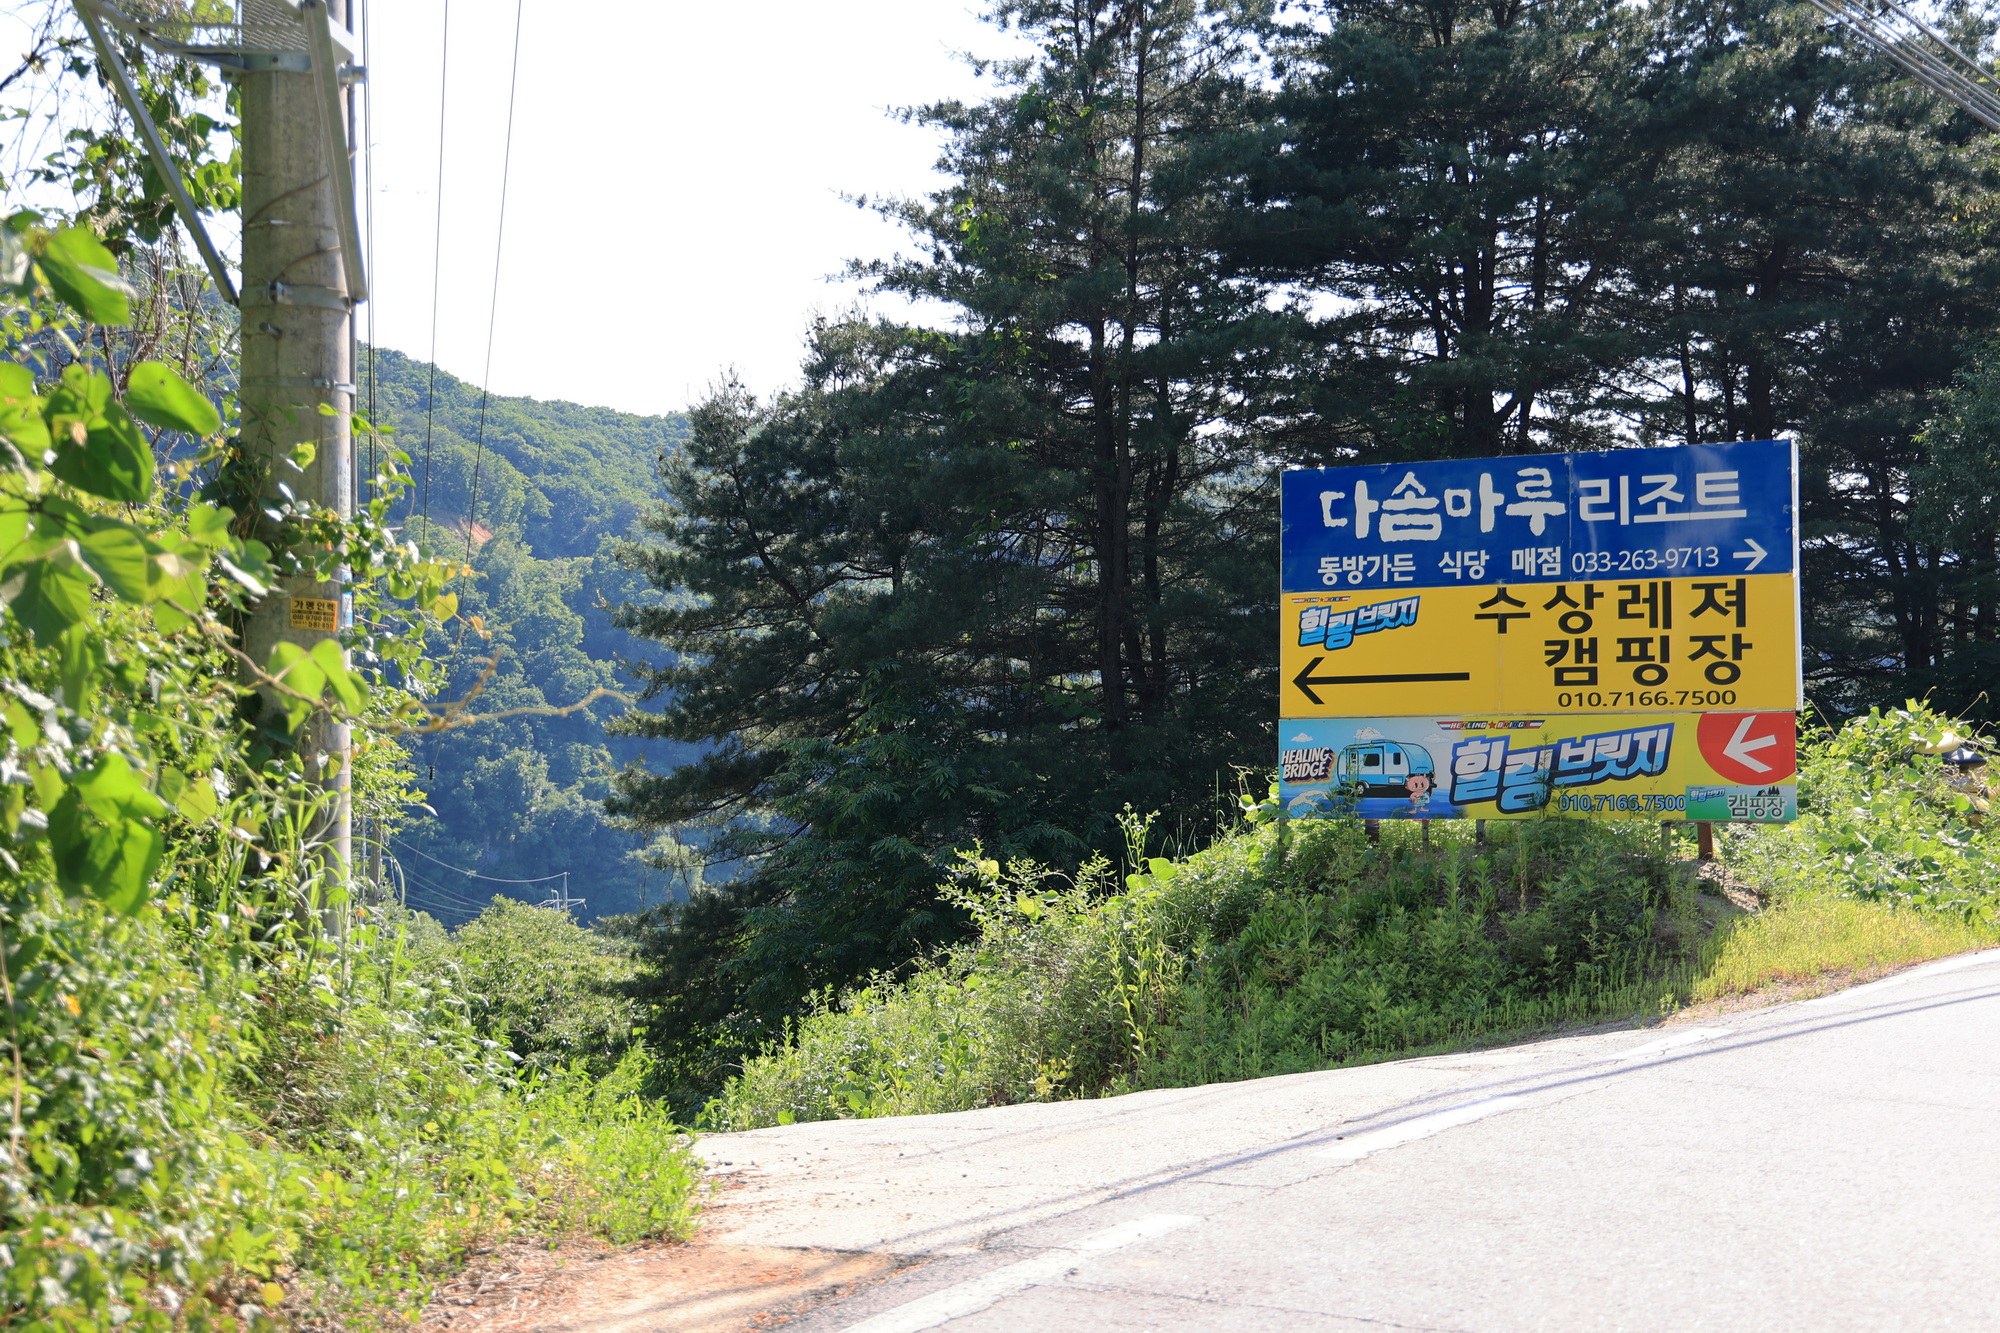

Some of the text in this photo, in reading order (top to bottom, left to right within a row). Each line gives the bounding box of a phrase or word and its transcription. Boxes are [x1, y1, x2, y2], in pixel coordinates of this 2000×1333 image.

[1319, 467, 1748, 543] 다솜마루 리조트
[1317, 546, 1720, 586] 동방가든 식당 매점 033-263-9713
[1474, 577, 1748, 635] 수상레져
[1544, 633, 1753, 687] 캠핑장
[1557, 689, 1737, 709] 010.7166.7500
[1281, 746, 1331, 764] HEALING
[1283, 761, 1327, 779] BRIDGE
[1558, 794, 1686, 812] 010.7166.7500
[1728, 793, 1787, 819] 캠핑장
